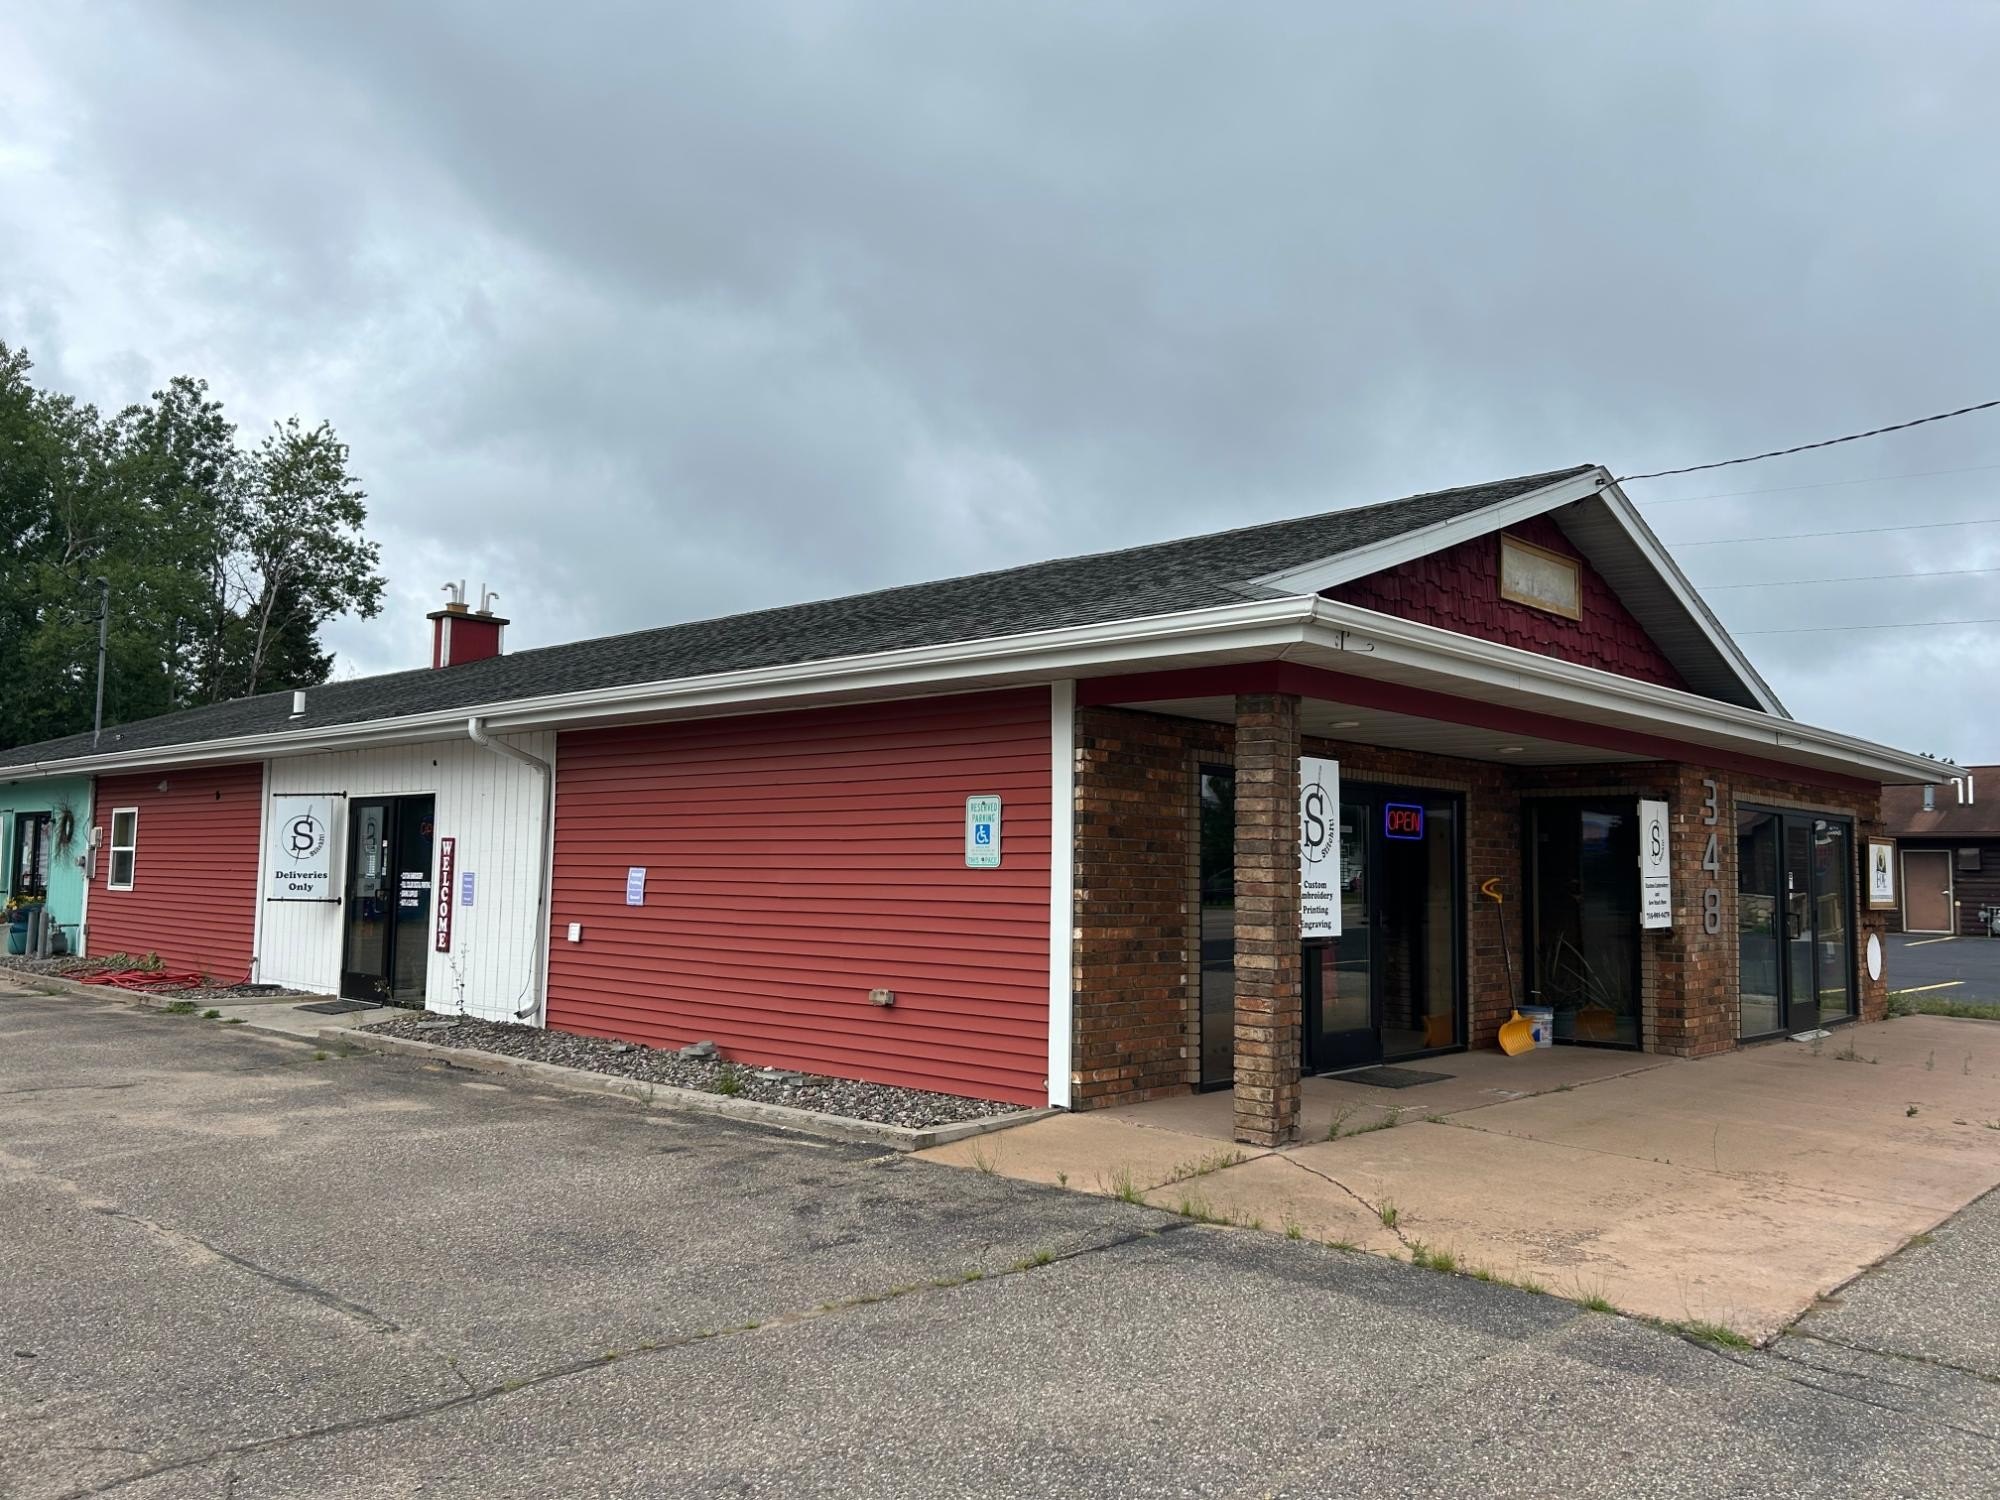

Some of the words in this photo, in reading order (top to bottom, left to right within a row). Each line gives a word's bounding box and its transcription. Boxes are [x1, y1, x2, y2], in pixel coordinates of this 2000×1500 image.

[970, 802, 997, 812] RESERVED
[972, 813, 995, 823] PARKING
[1388, 810, 1420, 832] OPEN
[275, 871, 328, 879] Deliveries
[288, 883, 314, 892] Only
[1303, 880, 1327, 889] Custom
[438, 841, 452, 948] WELCOME
[1301, 891, 1333, 901] mbroidery
[1303, 905, 1329, 915] Printing
